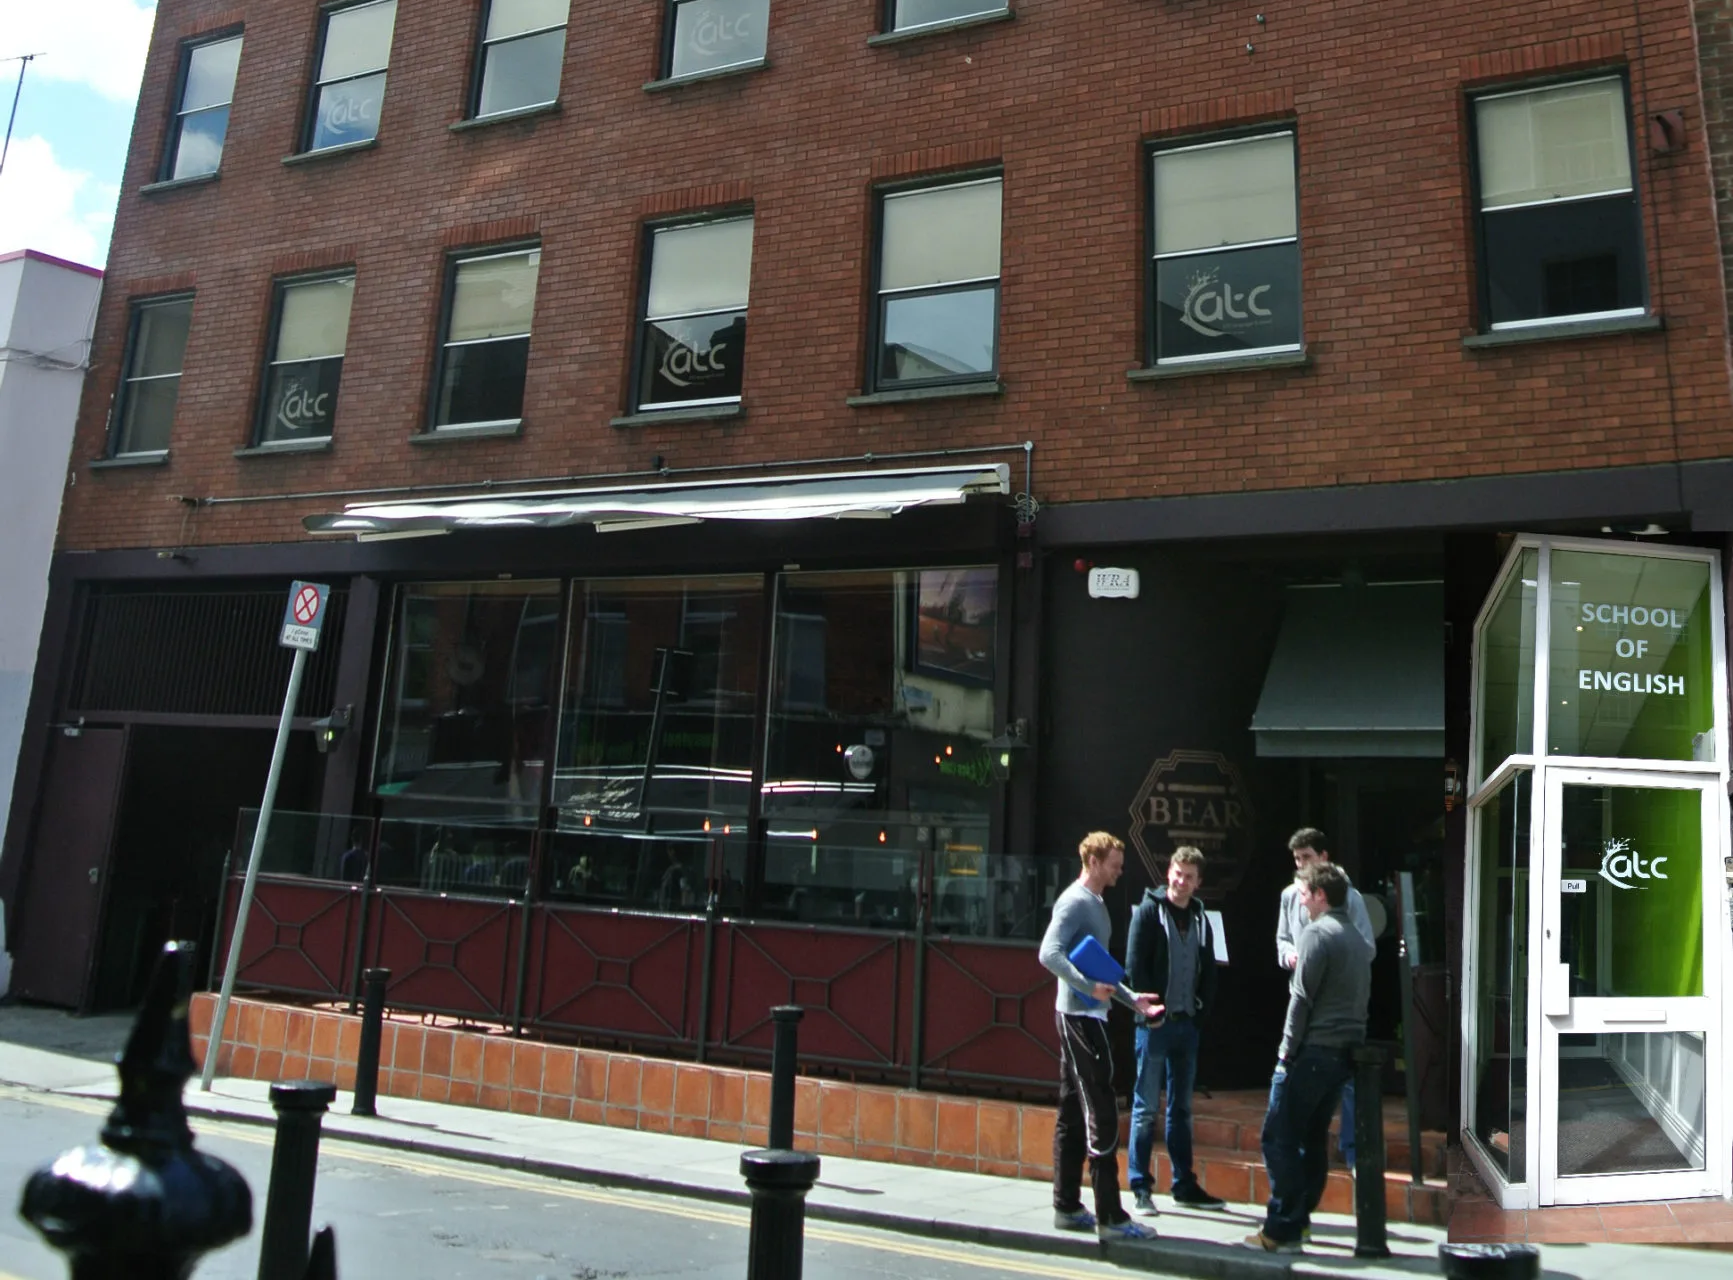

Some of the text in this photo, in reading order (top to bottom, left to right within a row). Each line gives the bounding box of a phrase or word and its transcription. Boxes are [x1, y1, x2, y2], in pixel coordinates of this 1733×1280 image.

[1195, 283, 1271, 322] atc
[671, 341, 727, 374] atc
[286, 391, 328, 419] atc
[1581, 603, 1682, 629] SCHOOL
[1615, 637, 1649, 659] OF
[1578, 669, 1686, 695] ENGLISH
[1148, 796, 1243, 828] BEAR
[1609, 850, 1668, 880] atc
[1567, 882, 1580, 890] Pull
